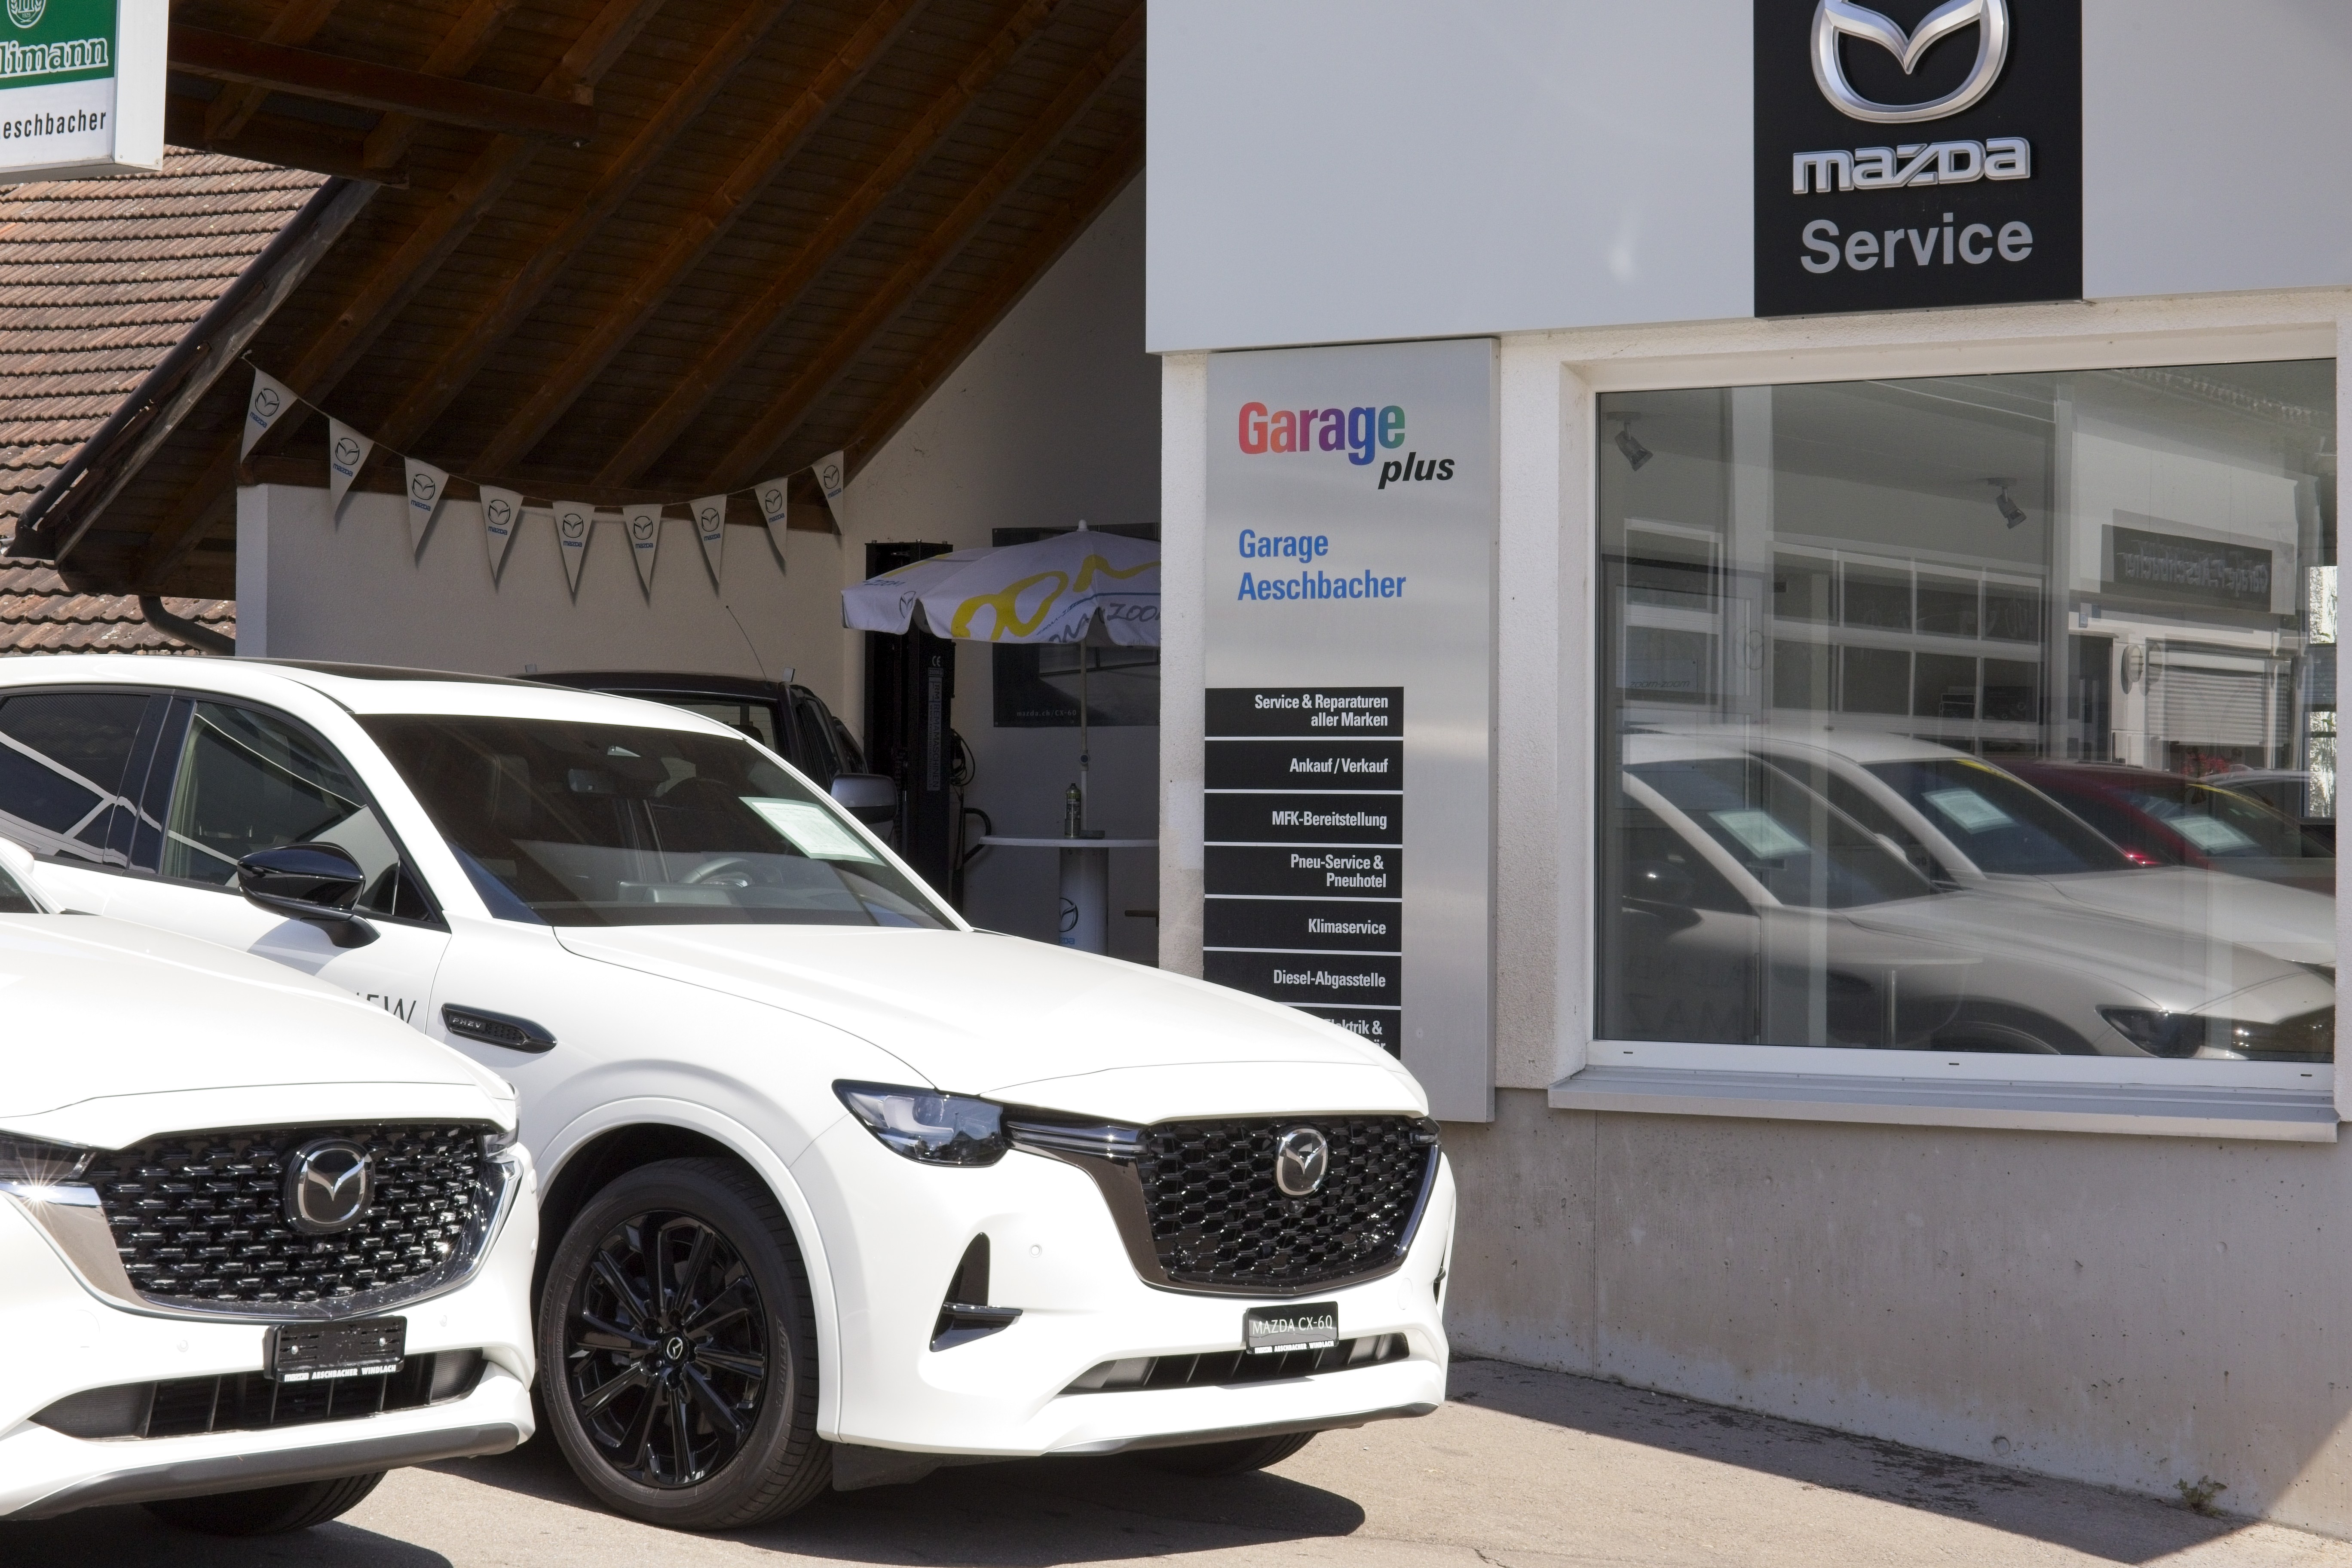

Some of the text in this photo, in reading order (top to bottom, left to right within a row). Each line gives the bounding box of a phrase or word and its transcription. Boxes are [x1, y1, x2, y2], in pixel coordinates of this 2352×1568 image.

[0, 109, 106, 139] eschbacher
[1792, 137, 2031, 194] mazda
[1801, 212, 2033, 274] Service
[249, 411, 267, 429] mazda
[1238, 401, 1406, 466] Garage
[333, 462, 353, 477] mazda
[1378, 451, 1455, 490] plus
[410, 499, 431, 511] mazda
[488, 526, 508, 536] mazda
[703, 533, 721, 542] mazda
[1239, 529, 1329, 564] Garage
[1237, 570, 1406, 601] Aeschbacher
[1255, 694, 1388, 712] Service & Reparaturen
[1017, 709, 1077, 717] mazda.ch/CX-60
[1311, 712, 1388, 726] aller Marken
[1289, 758, 1388, 774] Ankauf / Verkauf
[1272, 811, 1387, 830] MFK-Bereitstellung
[1291, 854, 1384, 870] Pneu-Service &
[1326, 873, 1387, 888] Pneuhotel
[1308, 918, 1387, 935] Klimaservice
[1274, 969, 1386, 989] Diesel-Abgasstelle
[452, 1017, 482, 1028] PHEV
[1324, 1018, 1383, 1035] ktrik &
[1253, 1318, 1295, 1335] MAZDA
[1274, 1343, 1307, 1353] AESCHBACHER
[1309, 1340, 1334, 1349] WINDLACH
[311, 1368, 358, 1380] AESCHBACHER
[361, 1364, 396, 1375] WINDLACH
